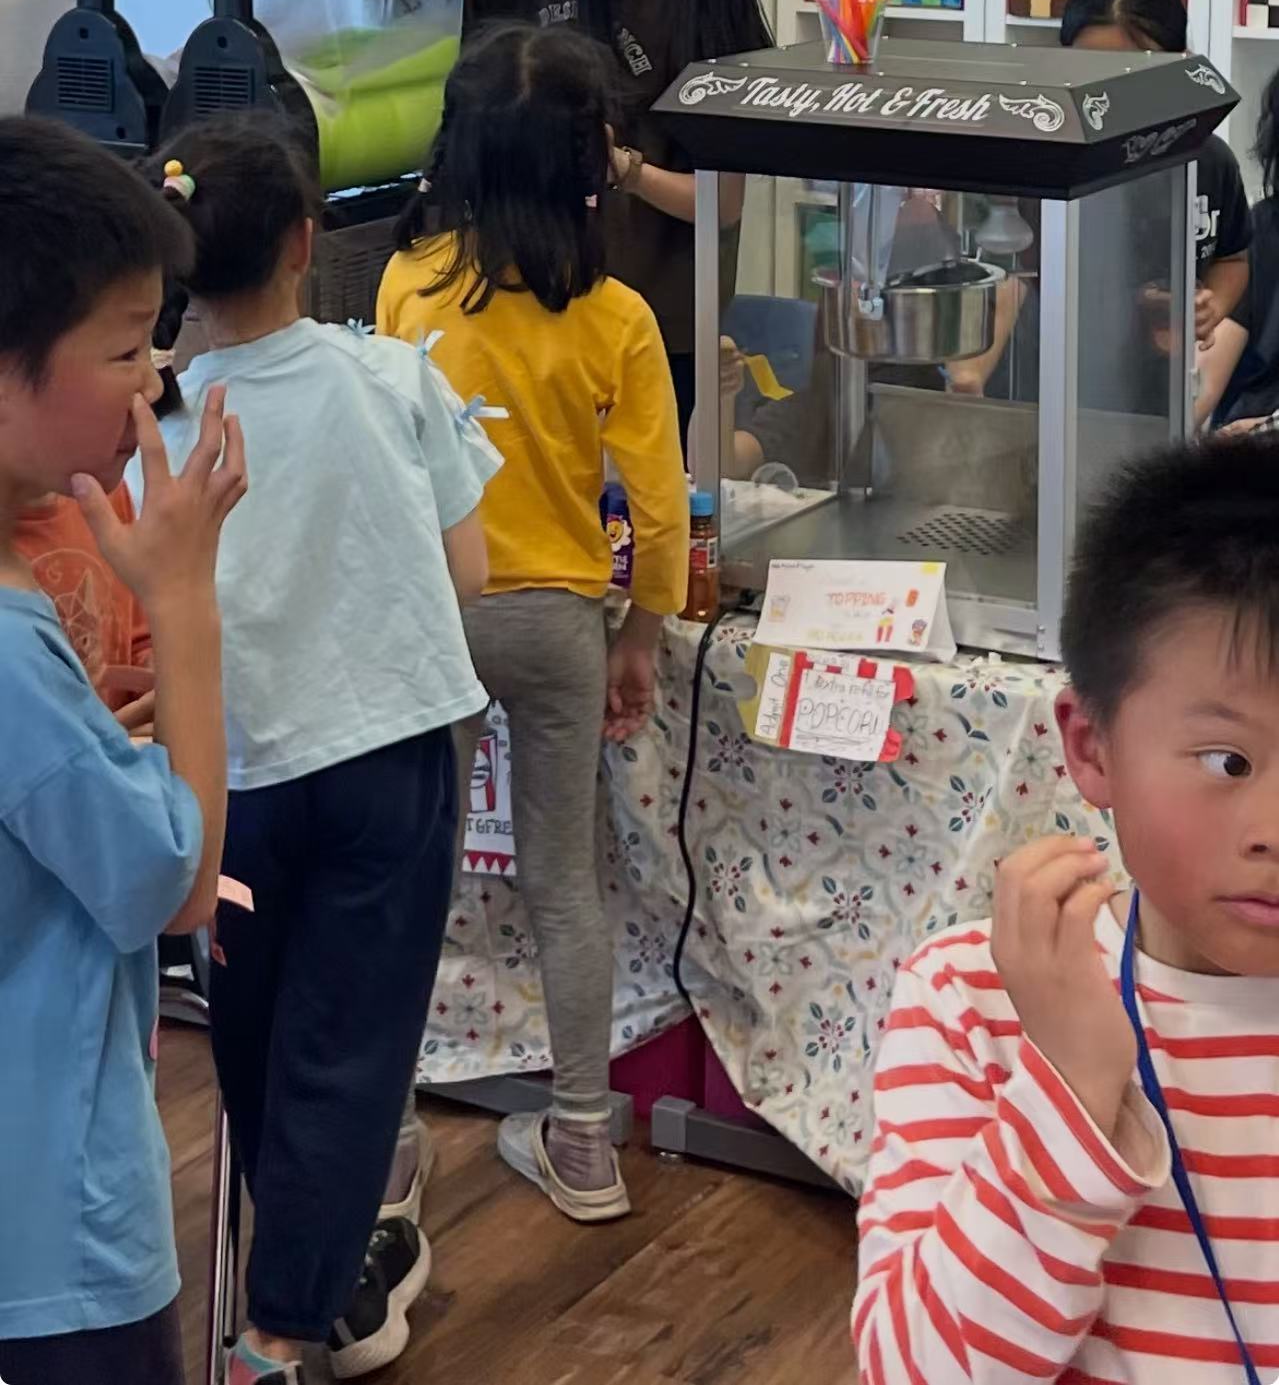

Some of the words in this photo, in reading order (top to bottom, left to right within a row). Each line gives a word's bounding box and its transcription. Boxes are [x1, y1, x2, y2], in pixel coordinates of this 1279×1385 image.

[740, 76, 820, 117] Tasty,
[822, 82, 881, 114] Hot
[880, 86, 912, 116] &
[907, 88, 992, 121] Fresh
[827, 590, 889, 607] TOPPING
